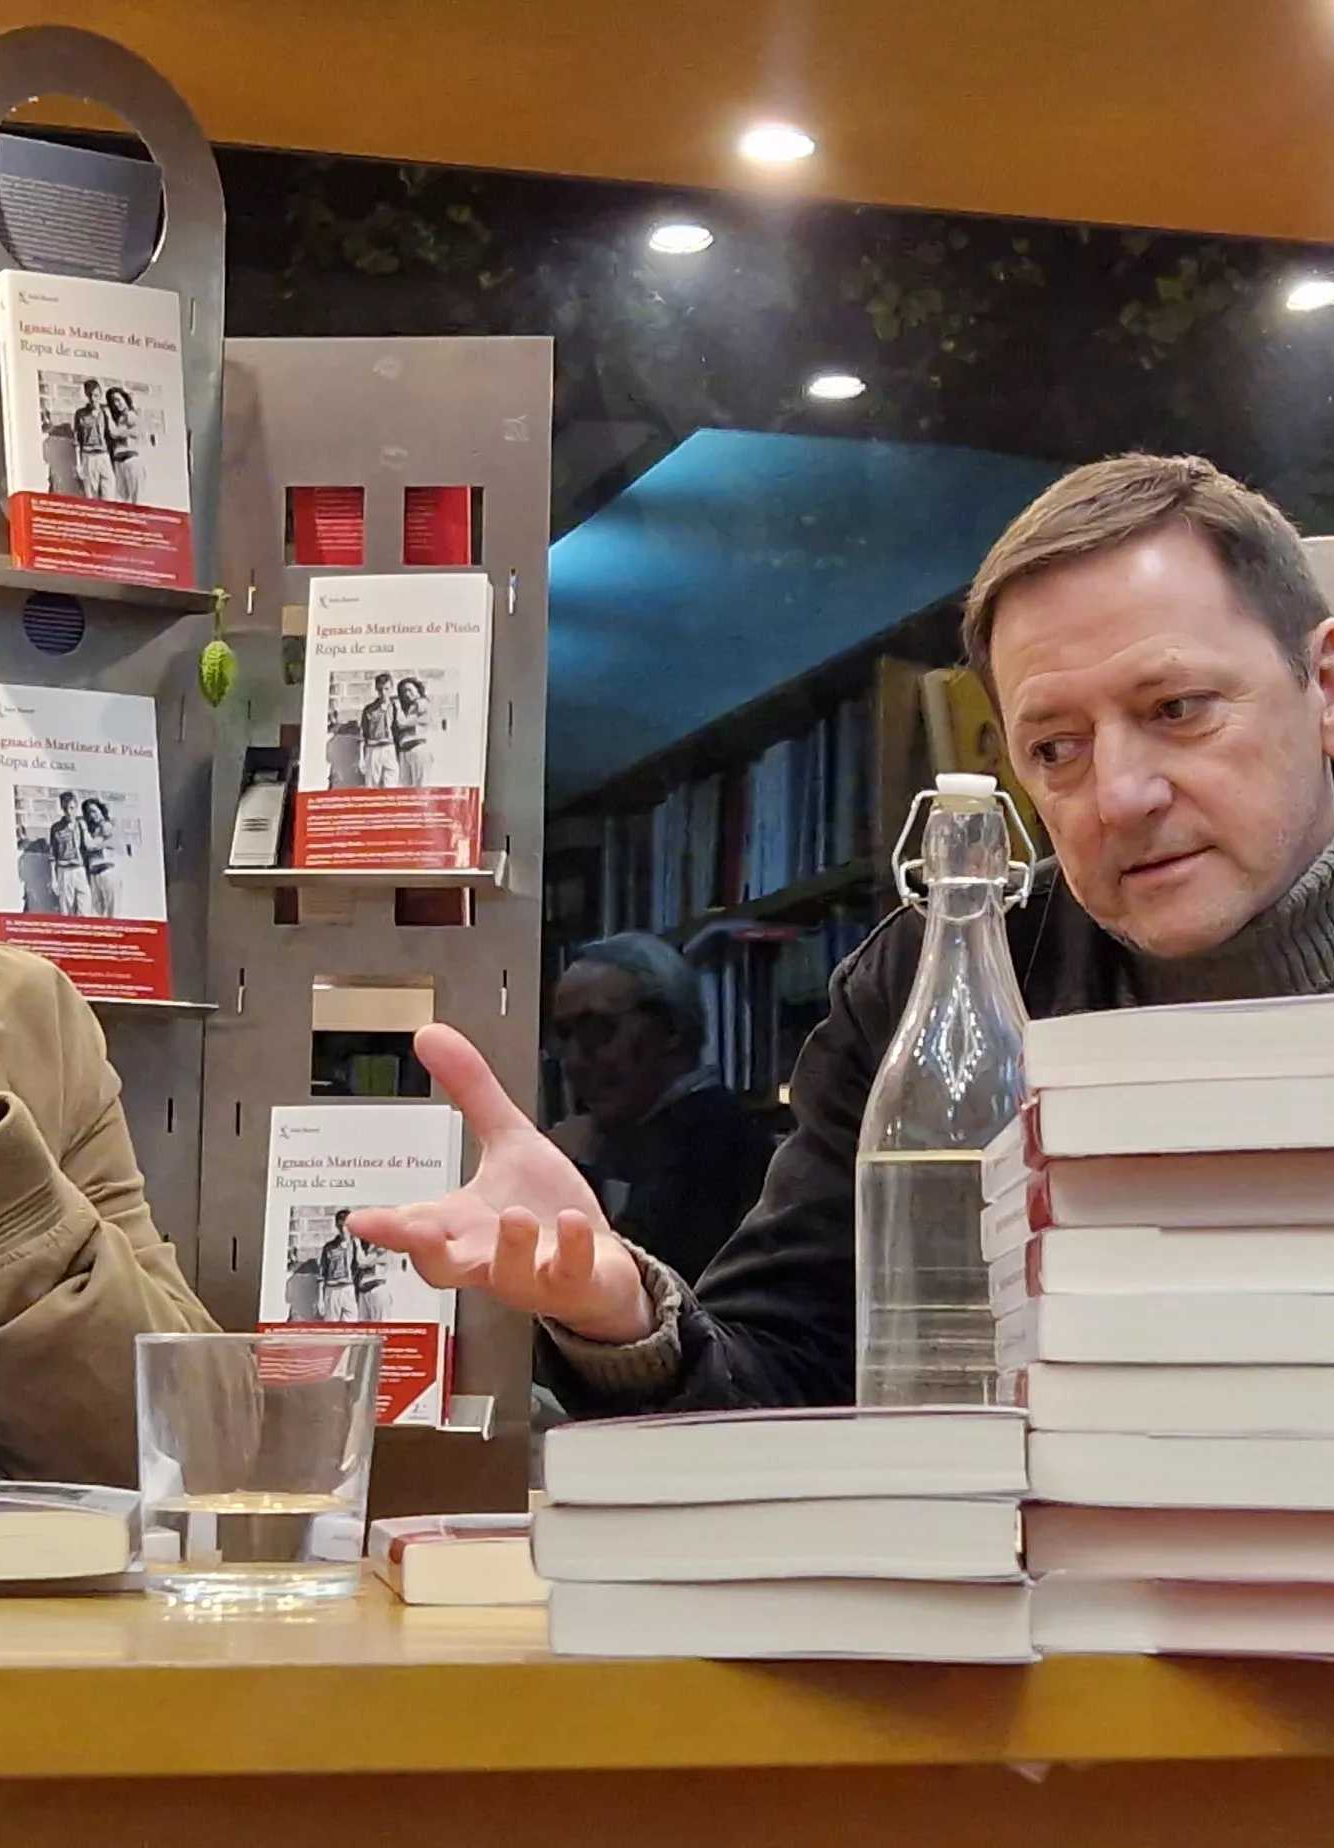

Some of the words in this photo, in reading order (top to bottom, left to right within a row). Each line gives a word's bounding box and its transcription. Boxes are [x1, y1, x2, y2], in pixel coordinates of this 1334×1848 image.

[19, 321, 65, 336] Ignacio
[128, 333, 141, 346] de
[20, 339, 53, 356] Ropa
[56, 342, 71, 355] de
[74, 347, 100, 360] casa
[317, 624, 363, 639] Ignacio
[427, 622, 441, 633] de
[315, 643, 348, 658] Ropa
[351, 641, 366, 654] de
[369, 644, 395, 653] casa
[104, 742, 117, 755] de
[32, 757, 47, 769] de
[50, 761, 76, 771] casa
[276, 1156, 323, 1171] Ignacio
[327, 1156, 384, 1168] Martínez
[388, 1156, 403, 1168] de
[406, 1156, 442, 1168] Pisón
[275, 1176, 307, 1191] Ropa
[311, 1175, 326, 1188] de
[329, 1179, 356, 1187] casa
